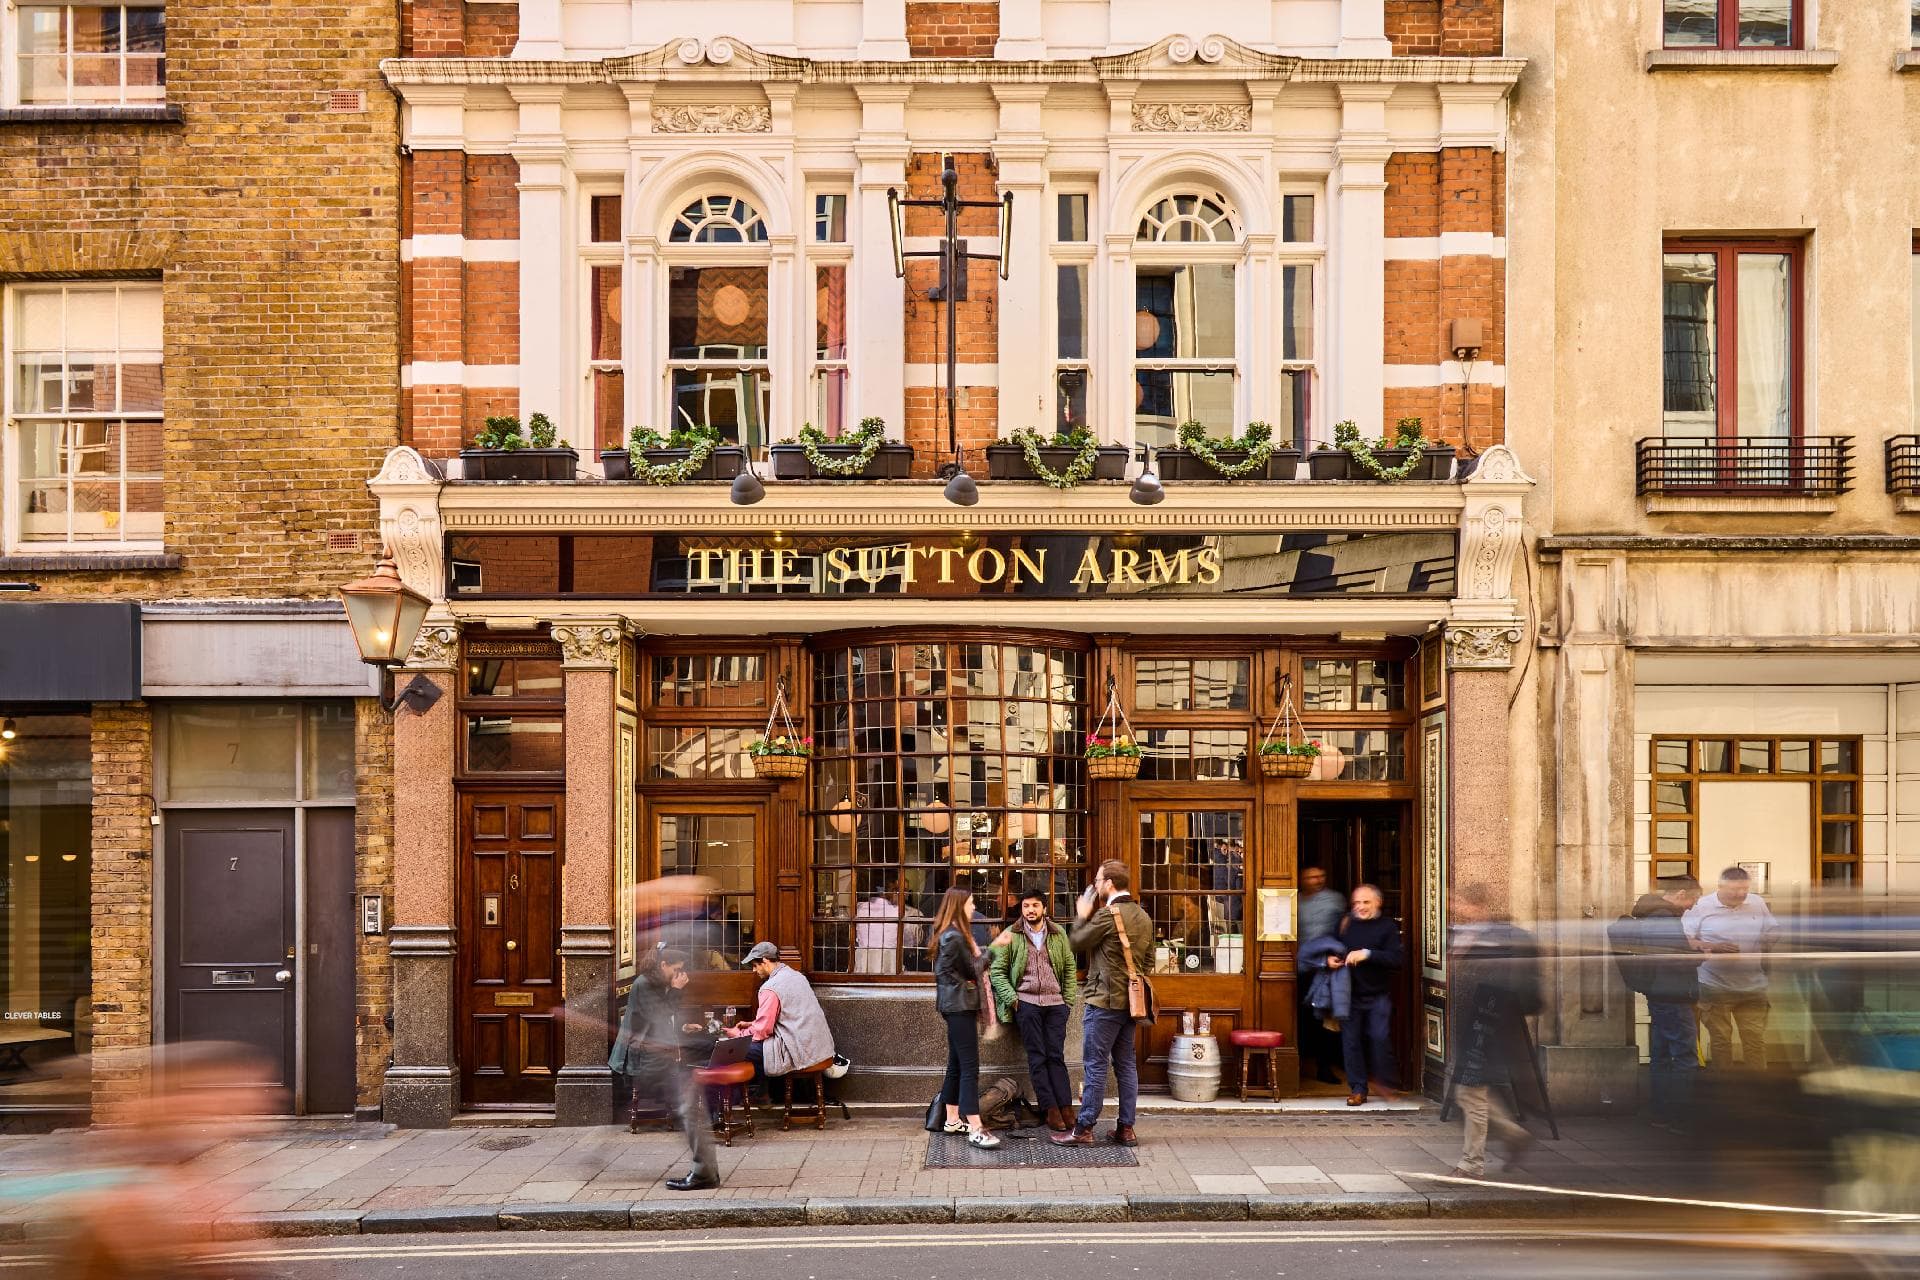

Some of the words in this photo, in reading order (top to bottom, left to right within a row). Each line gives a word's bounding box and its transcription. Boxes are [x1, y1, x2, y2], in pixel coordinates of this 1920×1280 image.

[688, 547, 801, 584] THE
[827, 547, 1047, 584] SUTTON
[1070, 547, 1221, 584] ARMS
[226, 743, 239, 764] 7
[230, 857, 238, 871] 7
[510, 874, 519, 890] 6
[4, 1011, 33, 1020] CLEVER
[33, 1011, 62, 1020] TABLES
